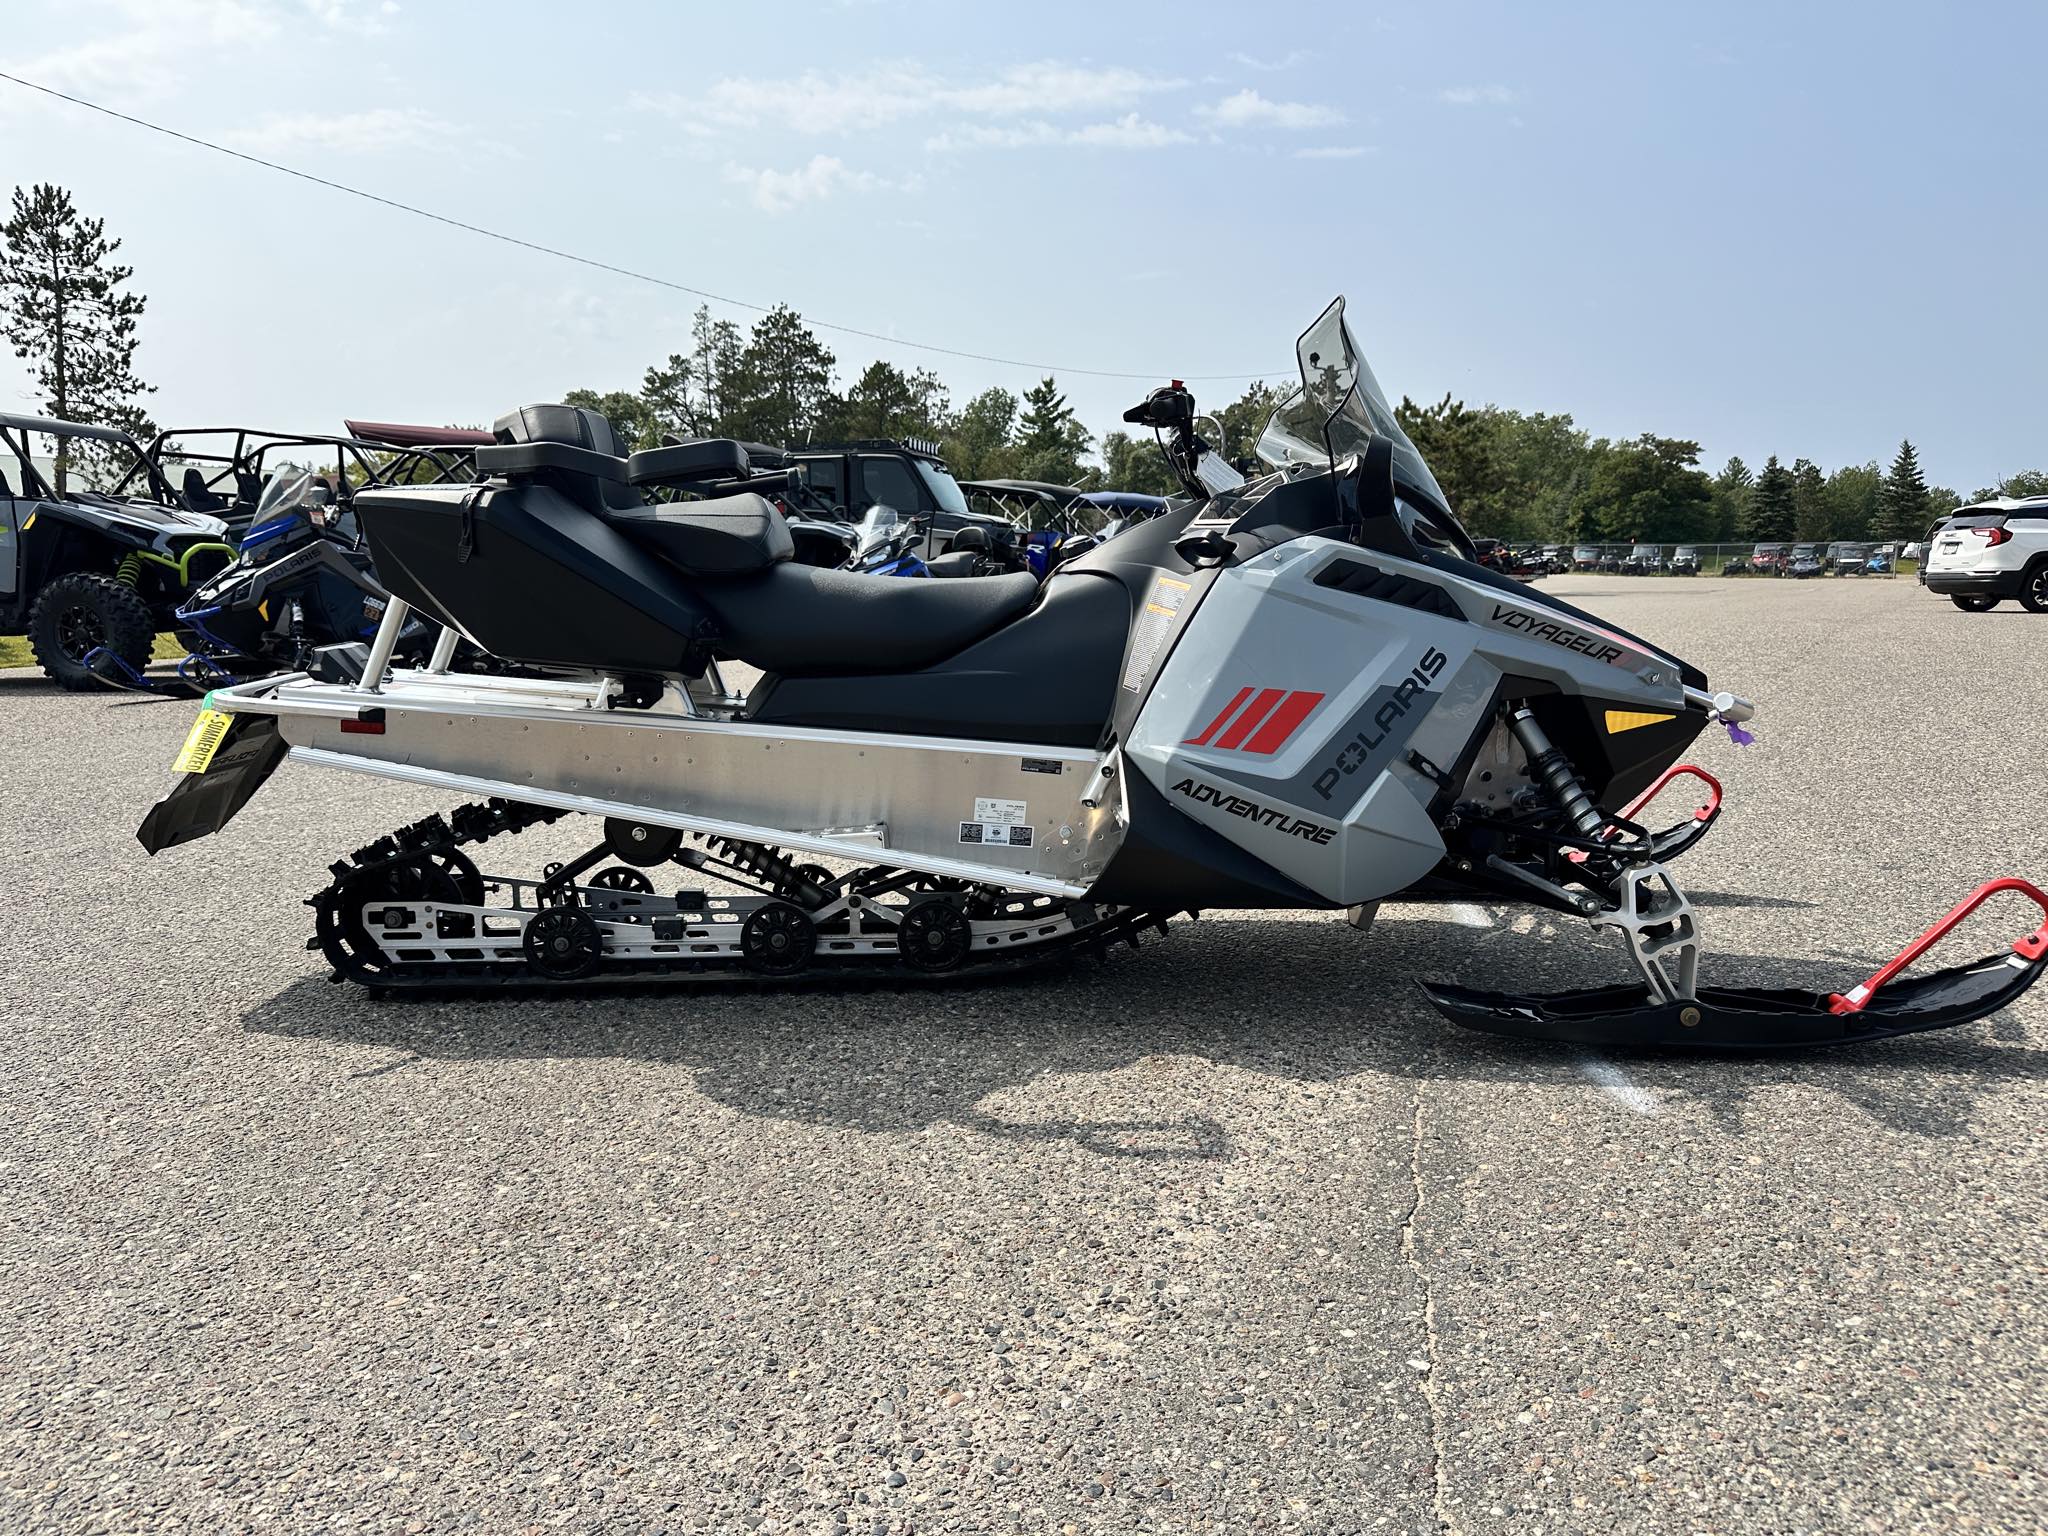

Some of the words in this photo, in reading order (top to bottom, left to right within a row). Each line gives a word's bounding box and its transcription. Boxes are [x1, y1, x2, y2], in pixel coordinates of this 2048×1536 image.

[263, 548, 322, 582] POLARIS
[1491, 605, 1624, 664] VOYAGEUR
[186, 719, 225, 771] SUMMERIZED
[1311, 646, 1448, 801] POLARIS
[1171, 778, 1338, 845] ADVENTURE
